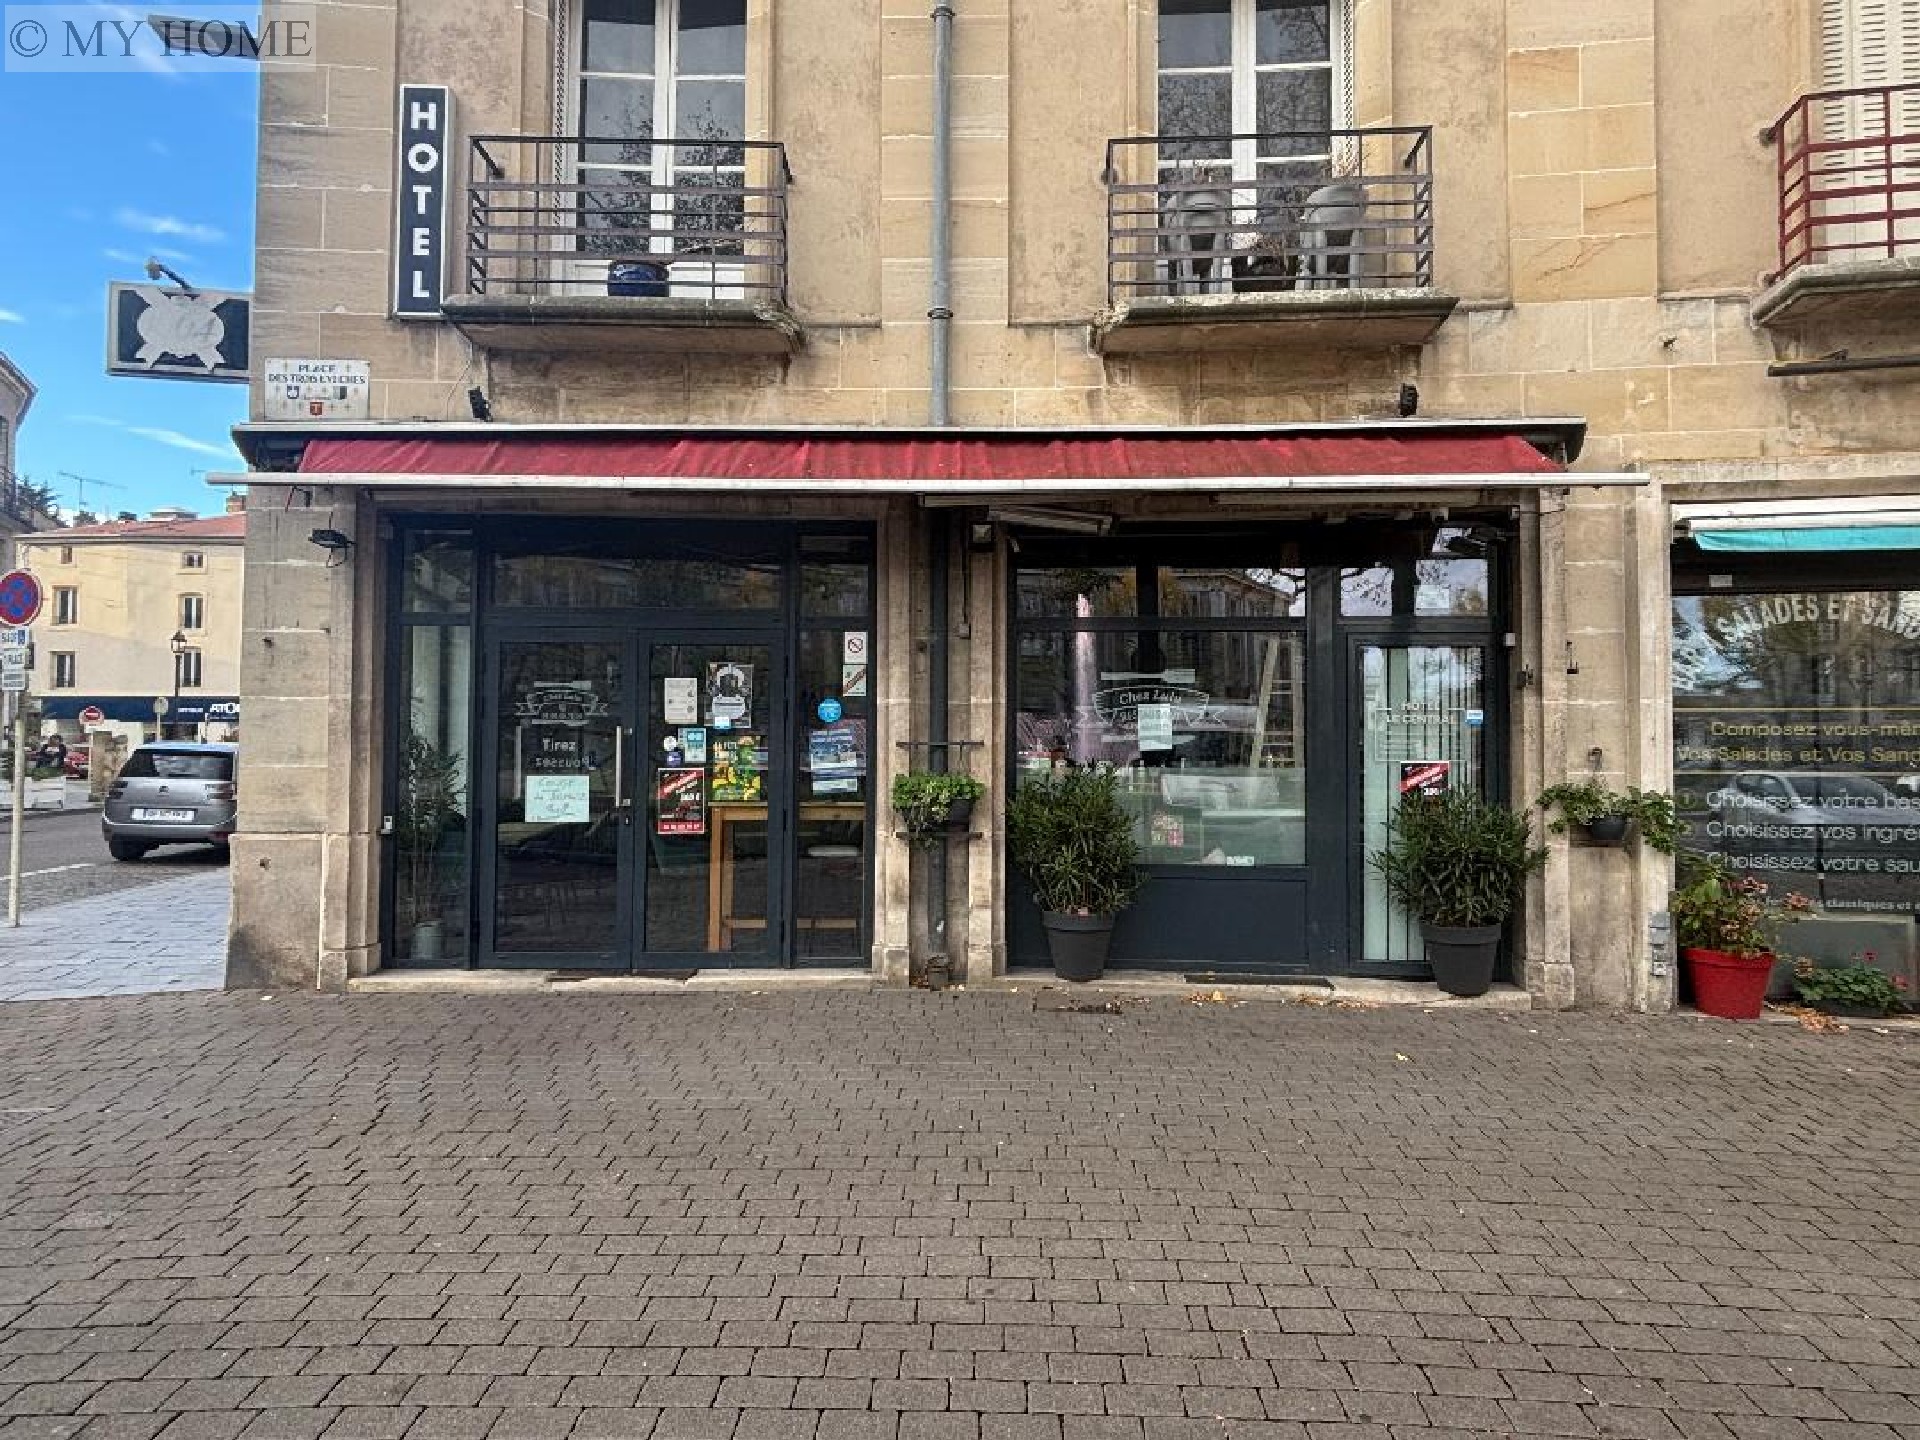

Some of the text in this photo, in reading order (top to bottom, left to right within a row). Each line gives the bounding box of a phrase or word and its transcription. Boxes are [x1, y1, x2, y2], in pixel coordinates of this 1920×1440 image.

[408, 101, 439, 297] HOTEL
[298, 364, 336, 373] PLACE
[1715, 594, 1820, 644] SALADES
[1827, 594, 1857, 622] ET
[1711, 721, 1817, 737] Composez
[542, 737, 576, 752] Tirez
[1719, 746, 1793, 762] Salades
[1800, 748, 1824, 762] et
[1828, 747, 1865, 762] Vos
[1819, 793, 1878, 809] votre
[1706, 821, 1815, 838] Choisissez
[1819, 826, 1857, 840] vos
[1821, 856, 1879, 871] votre
